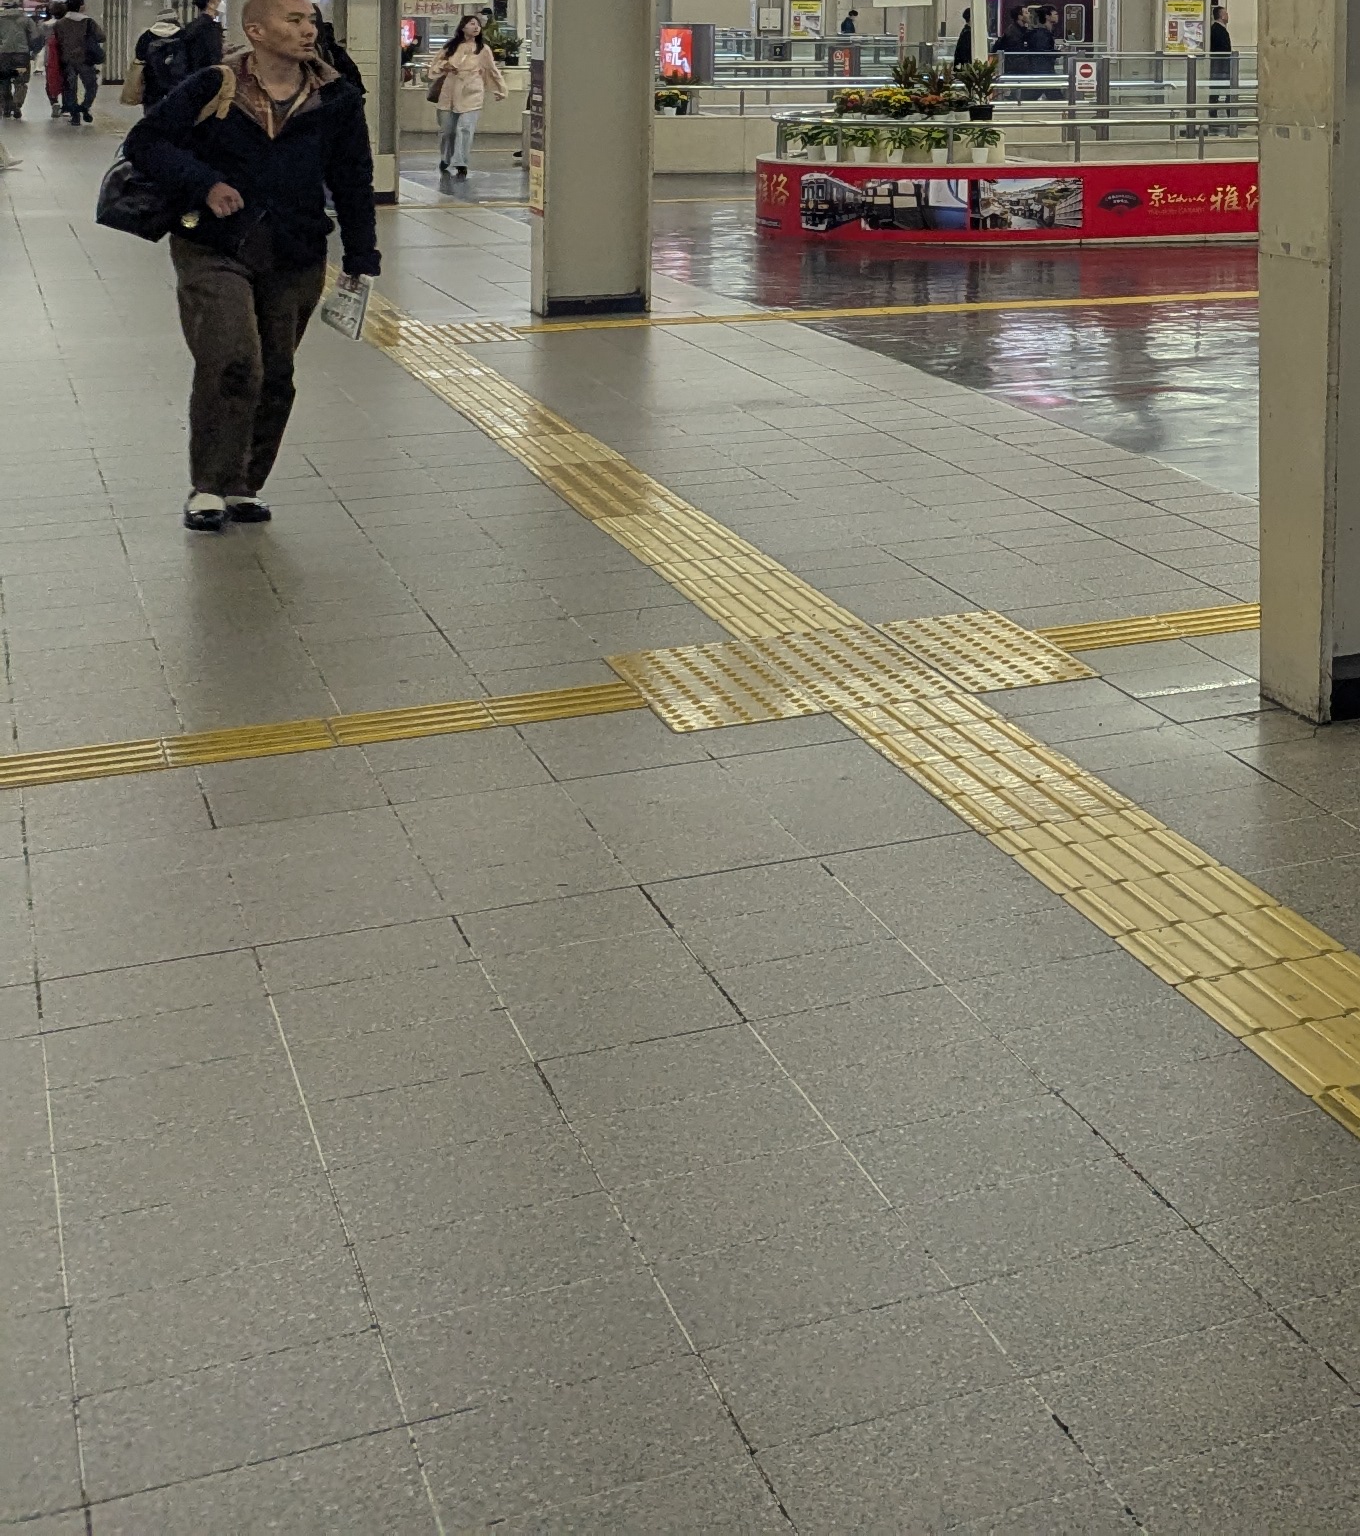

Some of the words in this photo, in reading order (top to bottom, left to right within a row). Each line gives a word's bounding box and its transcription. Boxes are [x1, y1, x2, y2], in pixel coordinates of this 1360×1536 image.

[1146, 184, 1207, 208] 京とれいん
